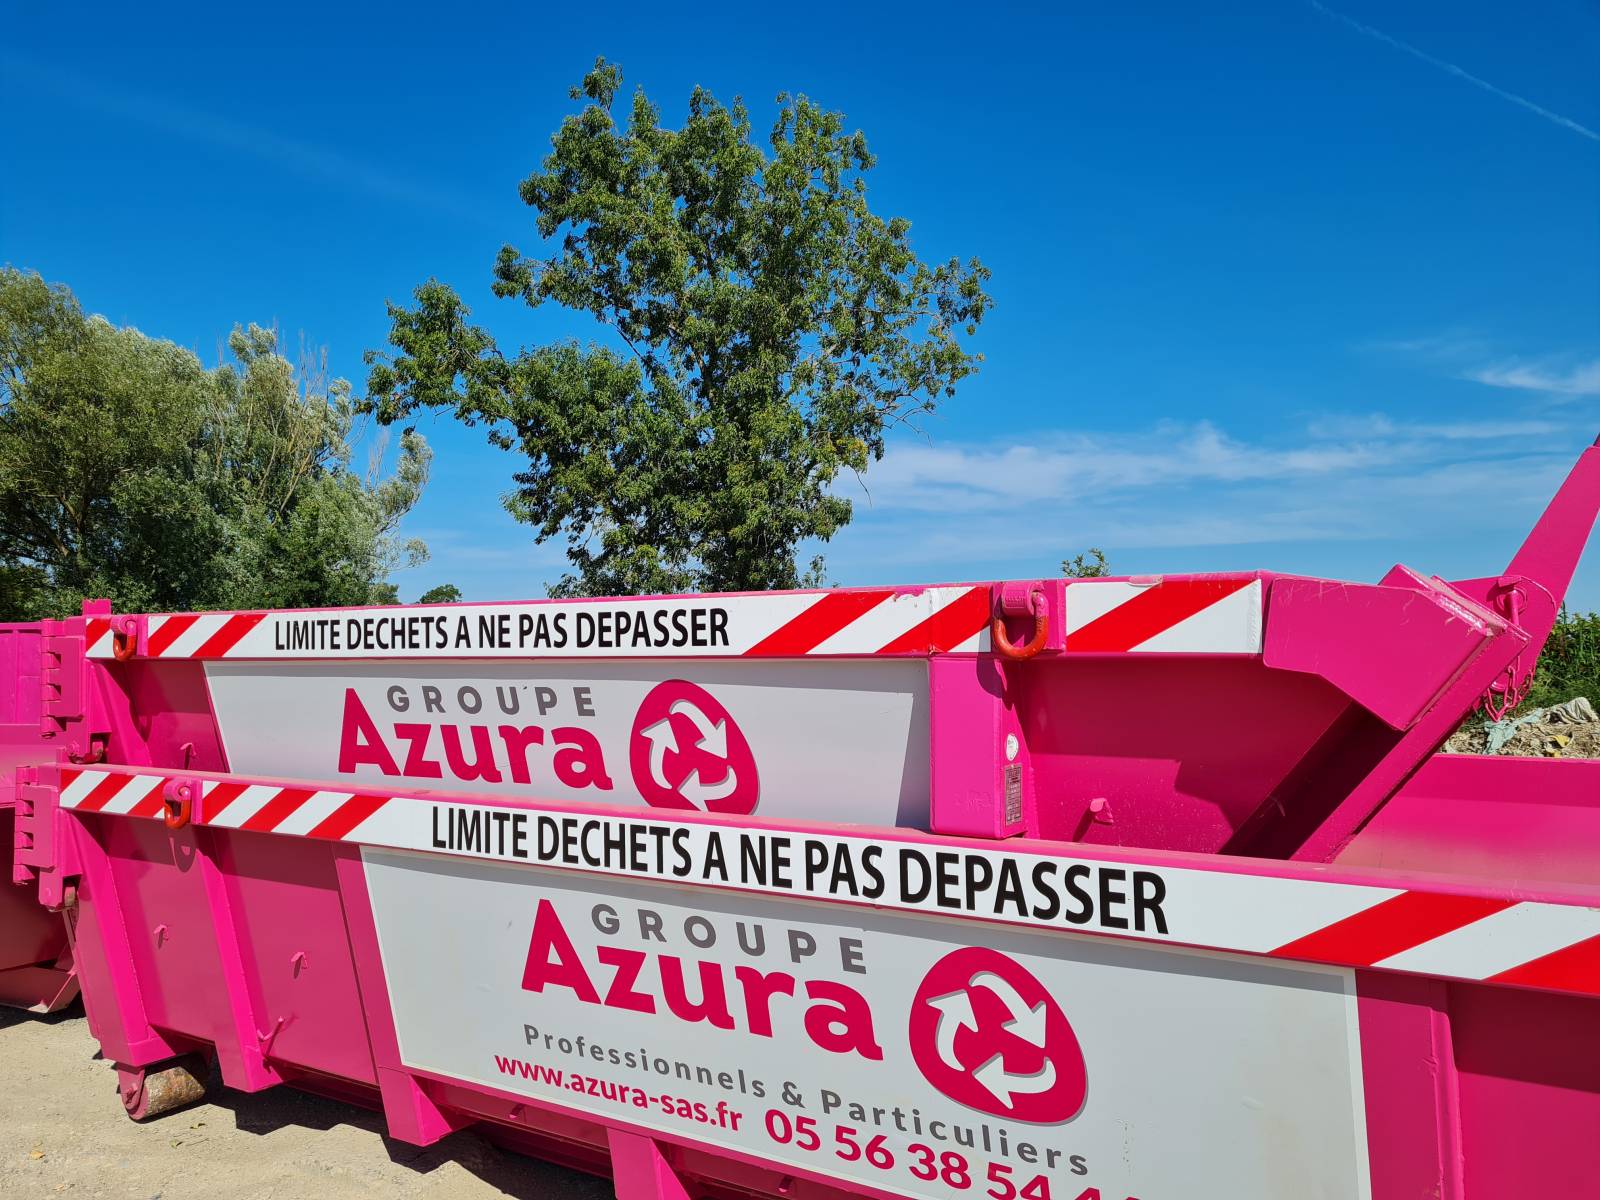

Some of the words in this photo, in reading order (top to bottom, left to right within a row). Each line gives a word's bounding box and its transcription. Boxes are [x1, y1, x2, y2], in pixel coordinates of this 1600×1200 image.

[275, 619, 341, 650] LIMITE
[347, 616, 448, 650] DECHETS
[455, 616, 472, 649] A
[479, 614, 511, 648] NE
[519, 612, 568, 648] PAS
[576, 608, 729, 648] DEPASSER
[338, 688, 613, 790] Azura
[387, 685, 596, 717] GROUPE
[432, 806, 528, 858] LIMITE
[537, 816, 692, 876] DECHETS
[702, 832, 728, 881] A
[741, 834, 793, 889] NE
[804, 840, 885, 899] PAS
[900, 848, 1169, 934] DEPASSER
[521, 898, 884, 1061] Azura
[591, 904, 867, 974] GROUPE
[494, 1055, 742, 1131] www.azura-sas.fr
[765, 1109, 821, 1151] 05
[835, 1125, 895, 1170] 56
[908, 1143, 972, 1190] 38
[987, 1162, 1051, 1200] 54
[524, 1024, 766, 1098] Professionnels
[781, 1081, 806, 1108] &
[821, 1089, 1088, 1176] Particuliers
